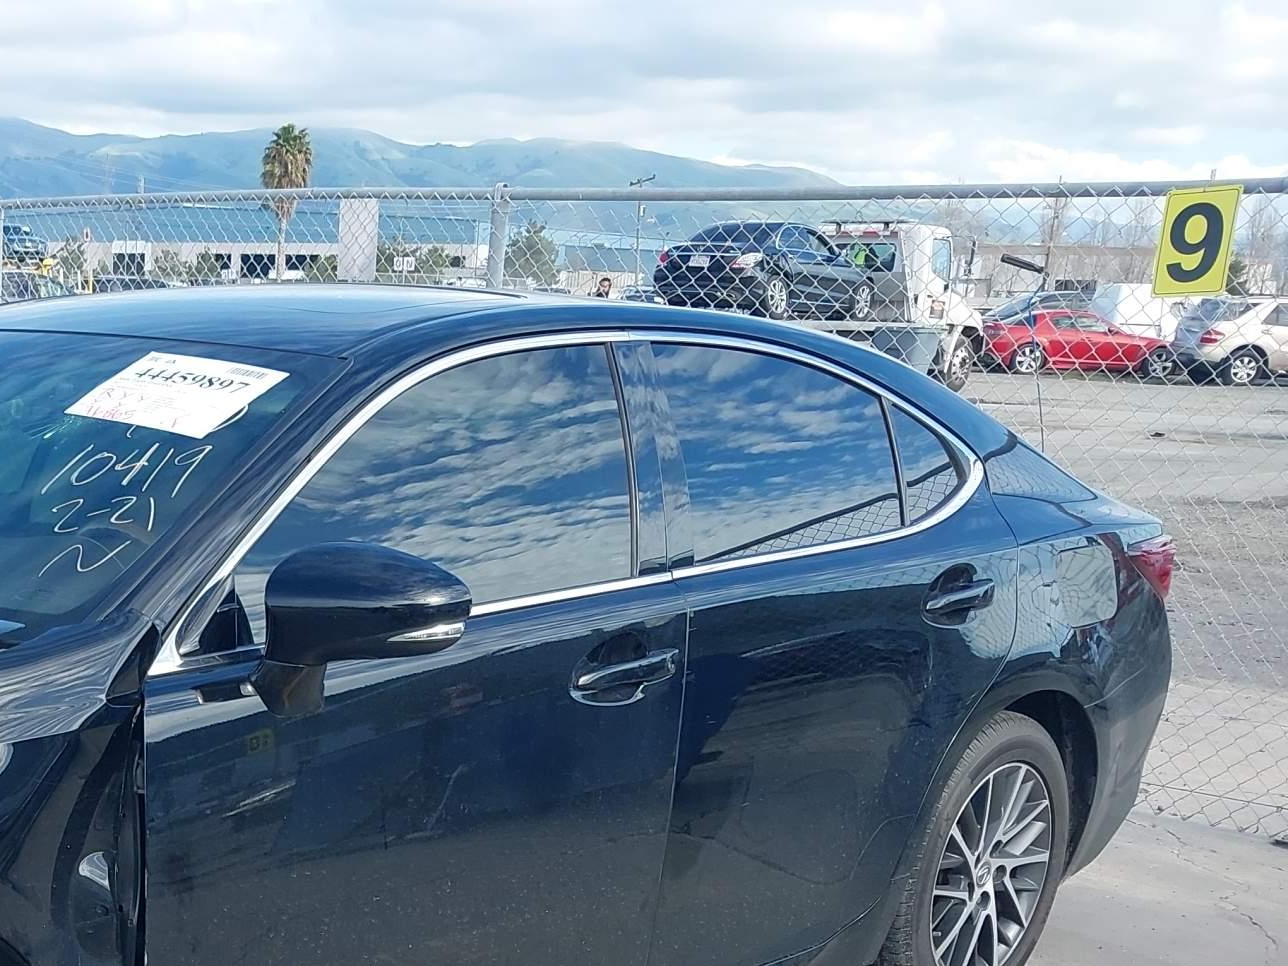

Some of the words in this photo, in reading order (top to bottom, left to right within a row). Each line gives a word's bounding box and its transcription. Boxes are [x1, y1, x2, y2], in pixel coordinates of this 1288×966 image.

[1166, 202, 1224, 283] 9
[135, 367, 252, 394] 44459897
[40, 442, 213, 498] 10419
